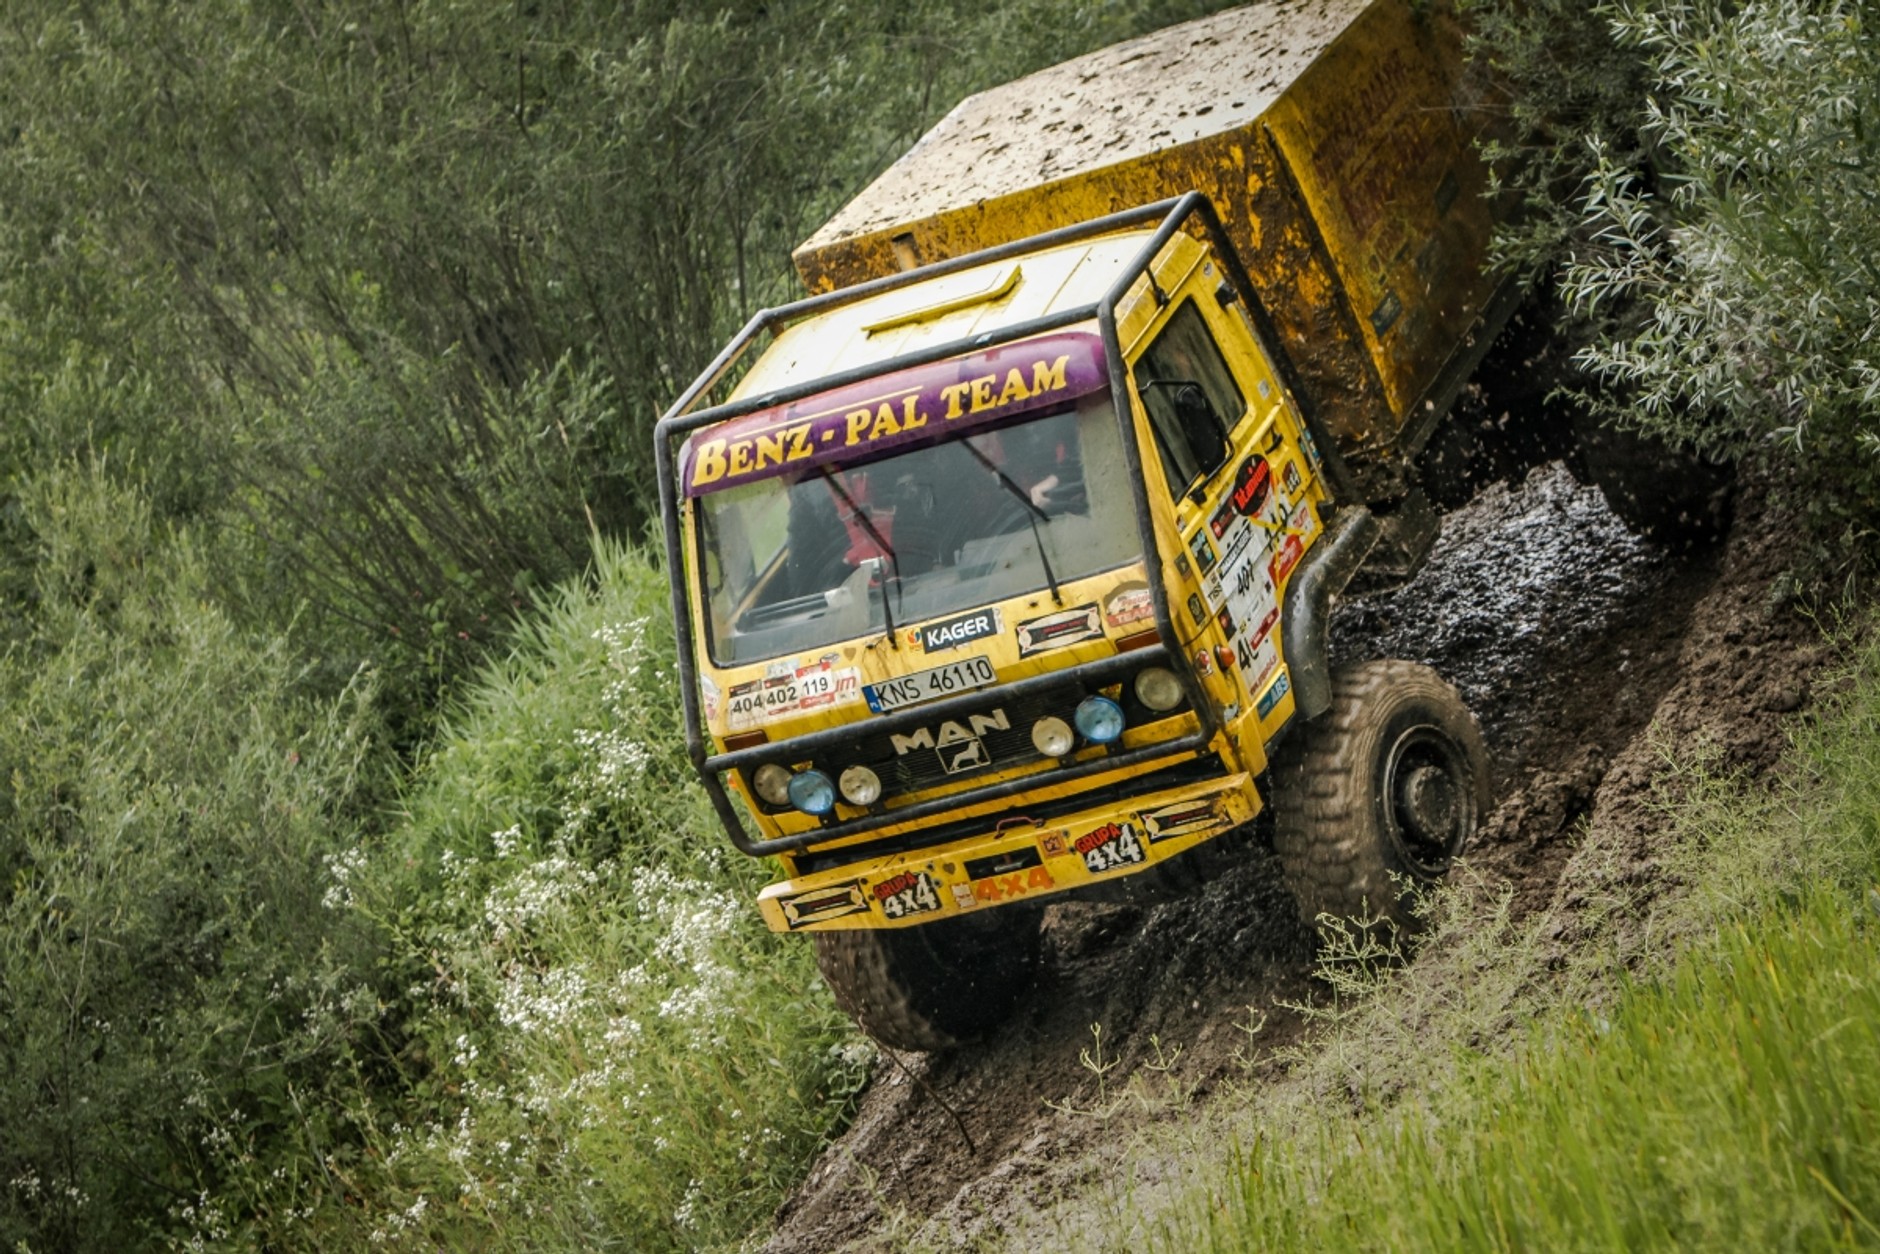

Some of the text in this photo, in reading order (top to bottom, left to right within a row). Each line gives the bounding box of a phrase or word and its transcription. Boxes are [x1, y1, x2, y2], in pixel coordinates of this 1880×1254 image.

[691, 422, 815, 488] BENZ
[844, 395, 928, 447] PAL
[941, 354, 1070, 421] TEAM
[927, 615, 990, 647] KAGER
[766, 686, 798, 706] 402
[803, 676, 829, 695] 119
[876, 659, 993, 708] KNS 46110
[731, 695, 763, 714] 404
[890, 708, 1011, 755] MAN
[1074, 822, 1122, 854] GRUPA
[873, 870, 919, 900] GRUPA
